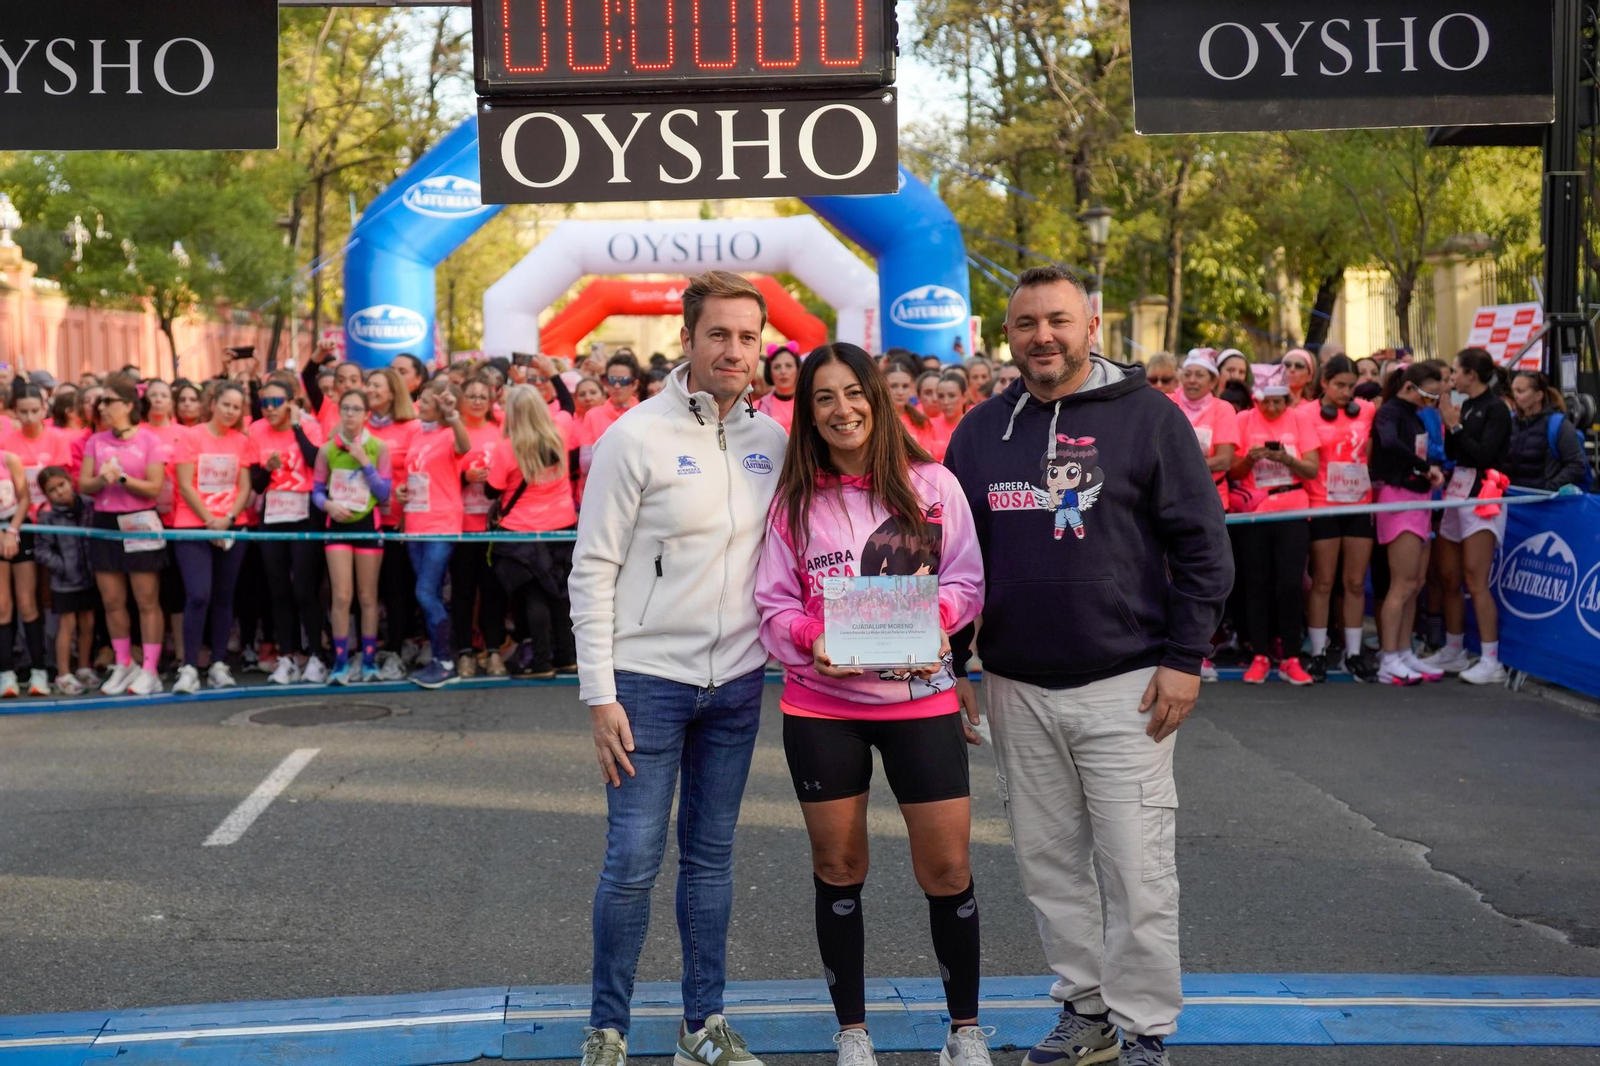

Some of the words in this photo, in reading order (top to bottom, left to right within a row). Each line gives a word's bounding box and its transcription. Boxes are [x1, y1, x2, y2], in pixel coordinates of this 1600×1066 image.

[1199, 12, 1490, 81] OYSHO
[500, 103, 878, 189] OYSHO
[608, 231, 761, 263] OYSHO
[988, 481, 1031, 491] CARRERA
[989, 491, 1036, 509] ROSA
[807, 549, 854, 572] ARRERA
[1501, 557, 1568, 603] ASTURIANA
